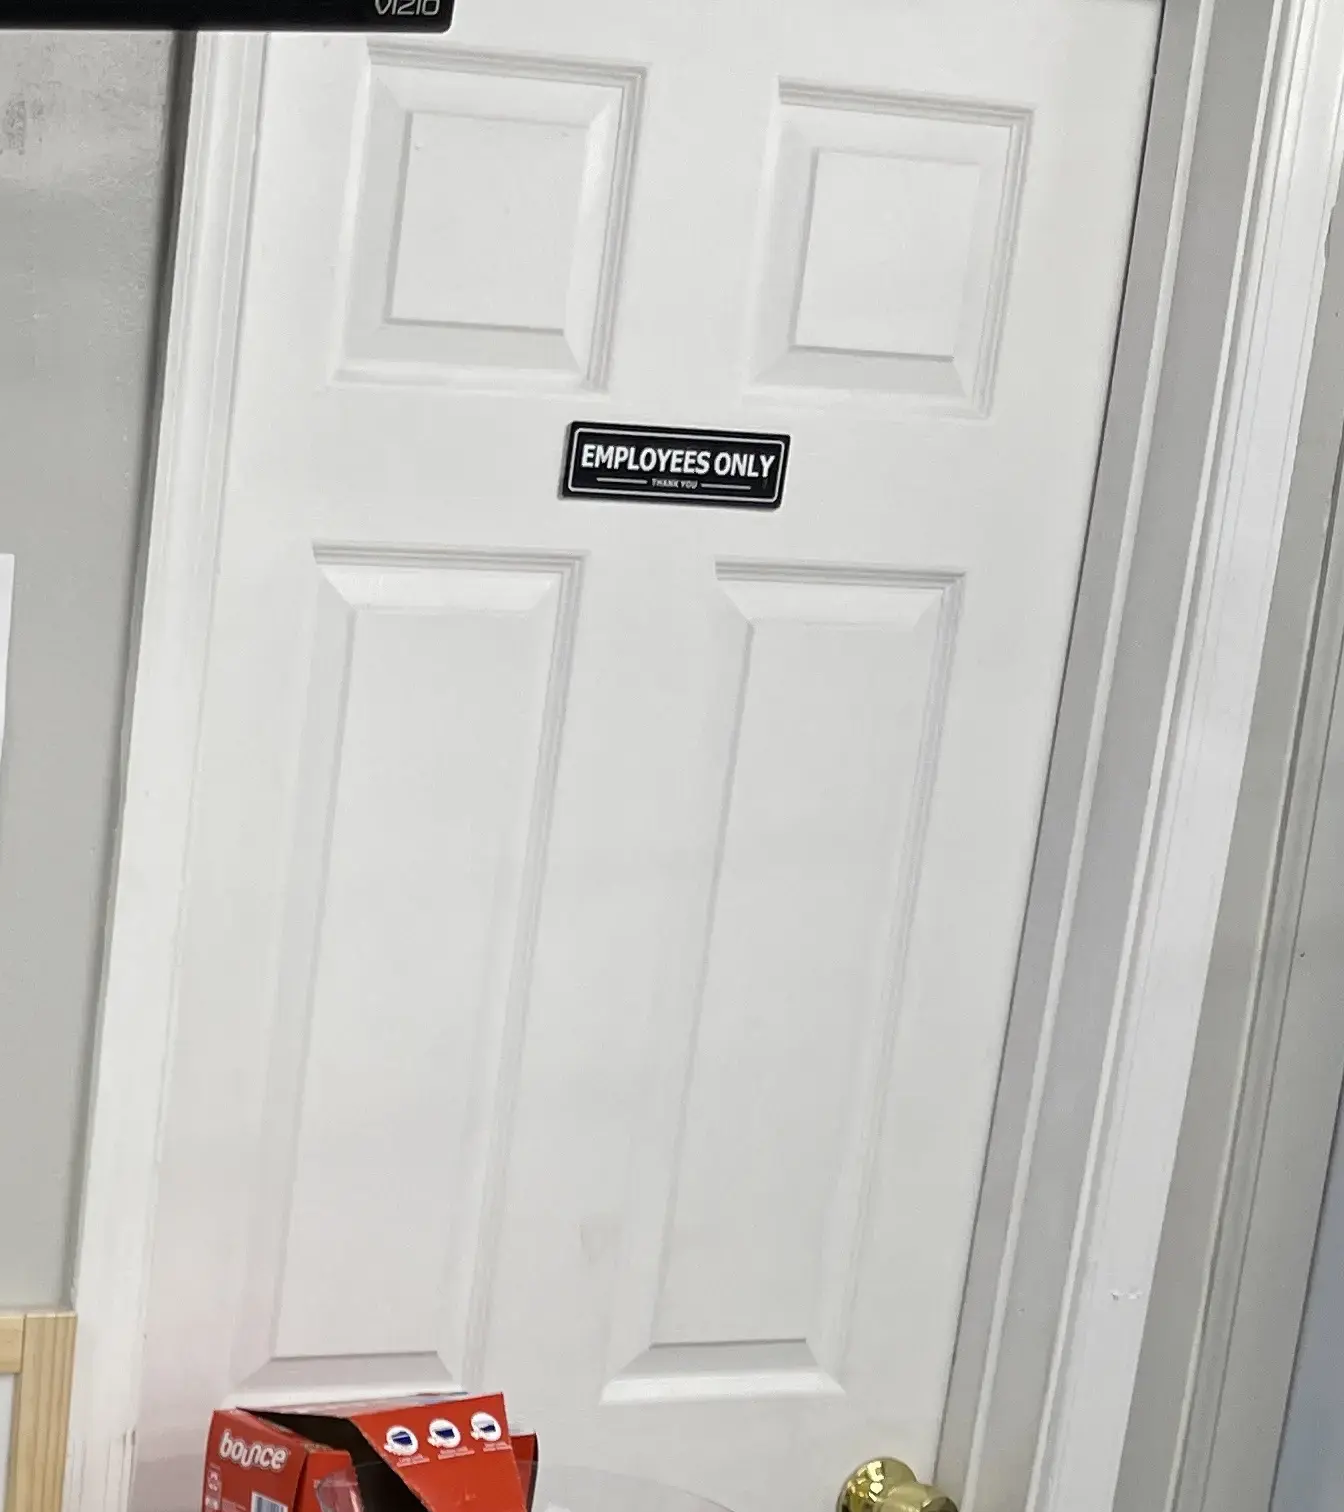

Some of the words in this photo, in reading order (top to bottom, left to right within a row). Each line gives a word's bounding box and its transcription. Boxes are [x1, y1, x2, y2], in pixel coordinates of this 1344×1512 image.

[374, 0, 441, 16] VIZIO
[580, 443, 711, 475] EMPLOYEES
[713, 452, 776, 478] ONLY
[650, 477, 678, 489] THANK
[679, 479, 699, 490] YOU
[219, 1430, 288, 1471] bounce
